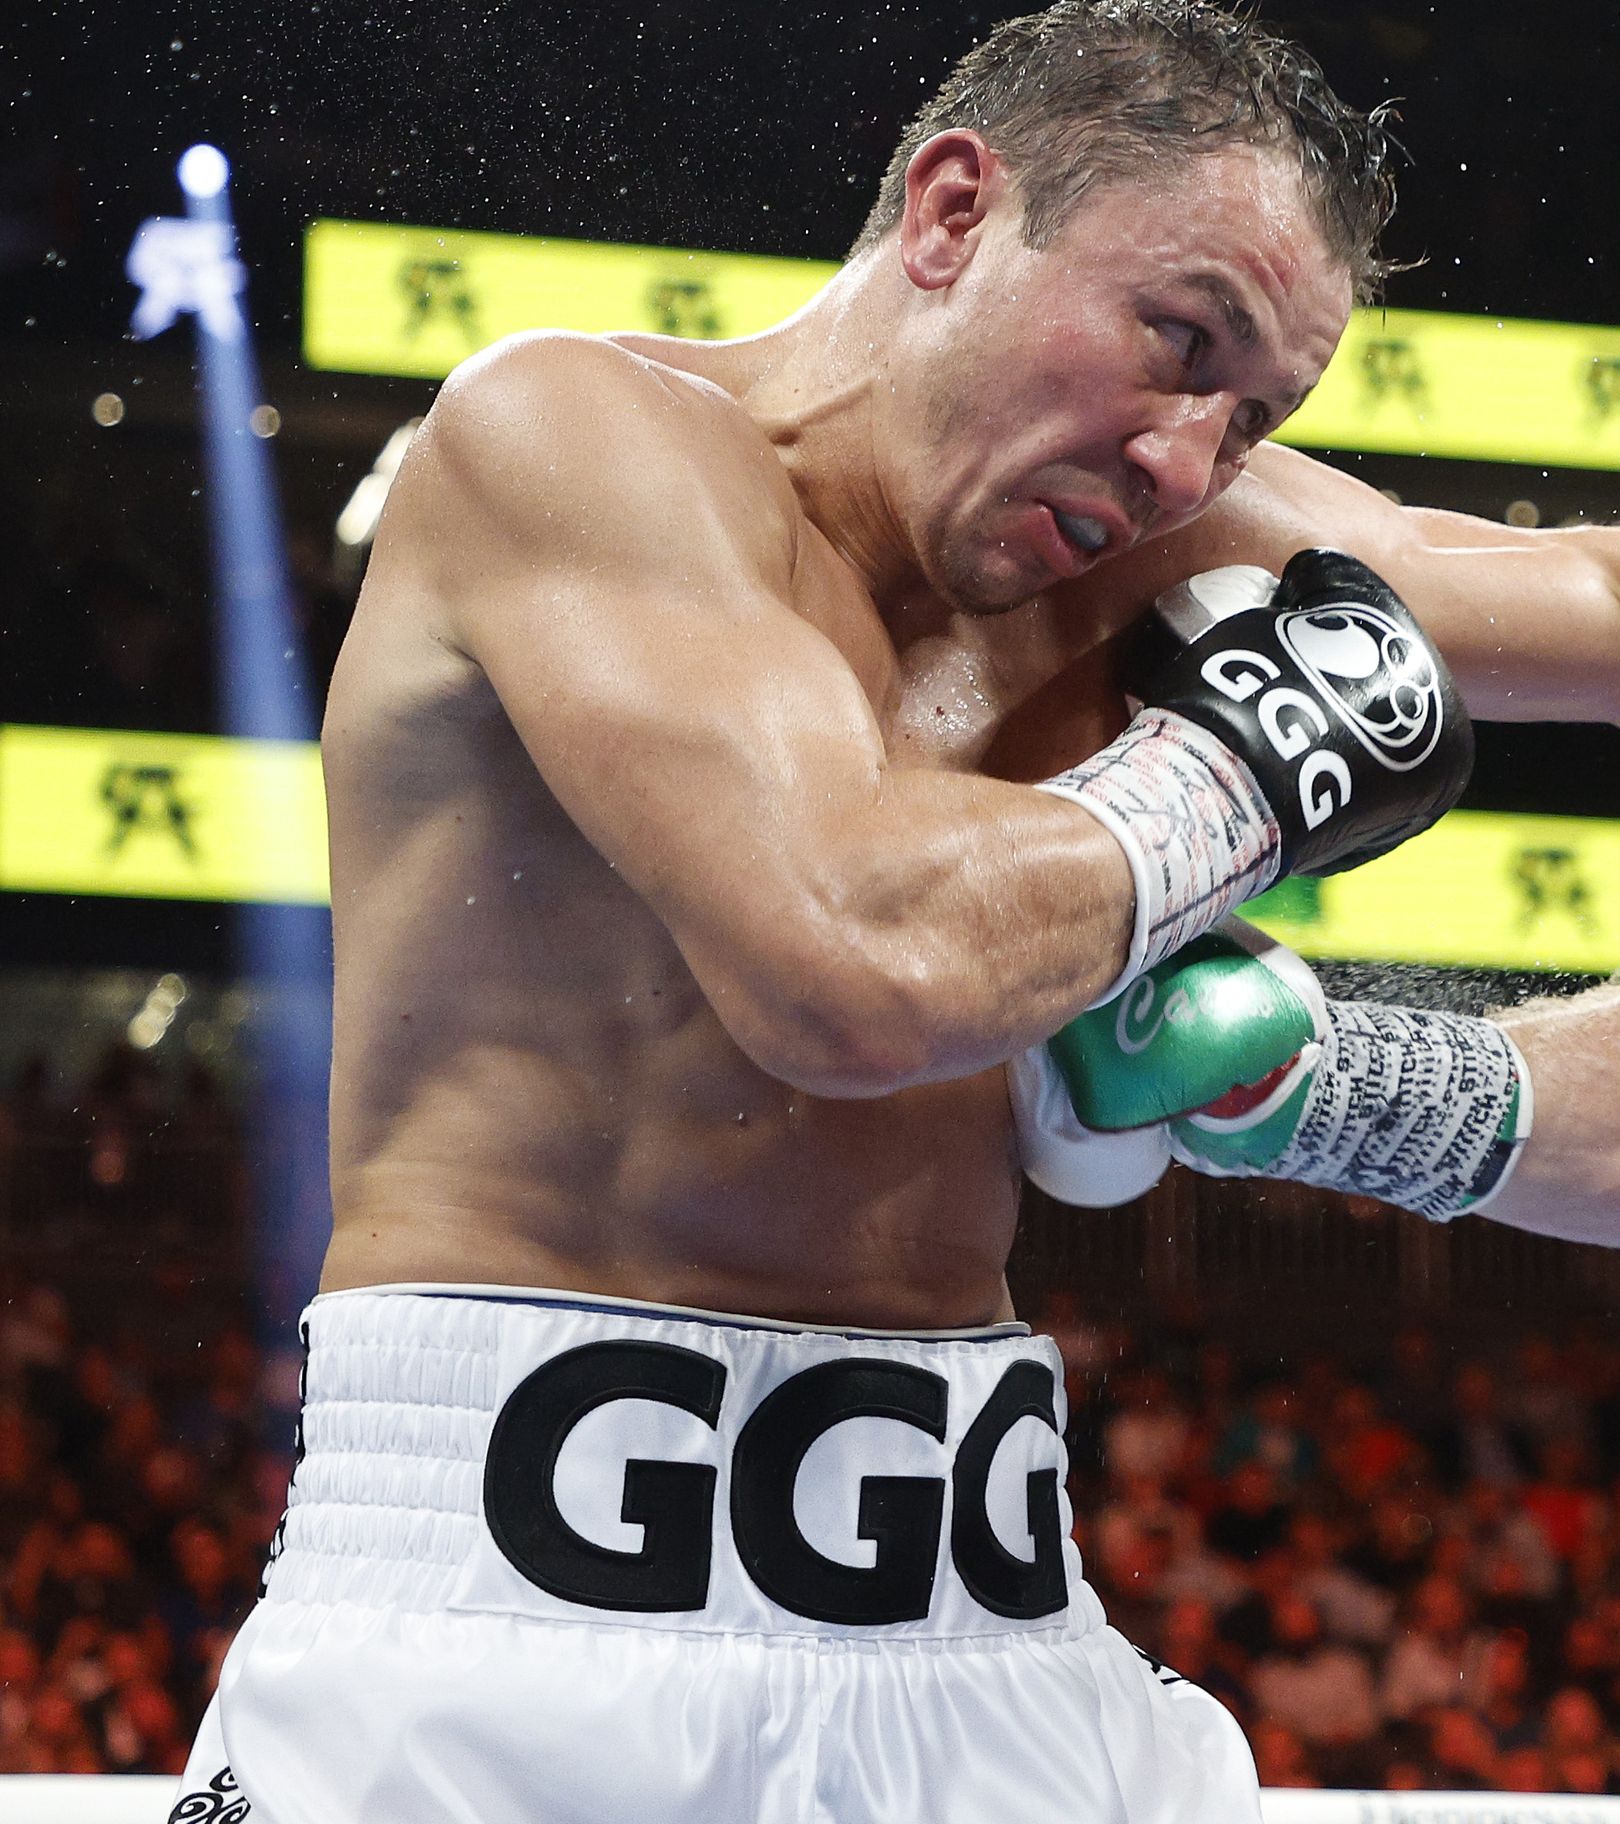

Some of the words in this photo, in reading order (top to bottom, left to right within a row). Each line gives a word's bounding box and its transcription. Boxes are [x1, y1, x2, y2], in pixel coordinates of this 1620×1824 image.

[1200, 648, 1352, 832] GGG
[1388, 1104, 1437, 1165] TITCH
[483, 1338, 1070, 1626] GGG
